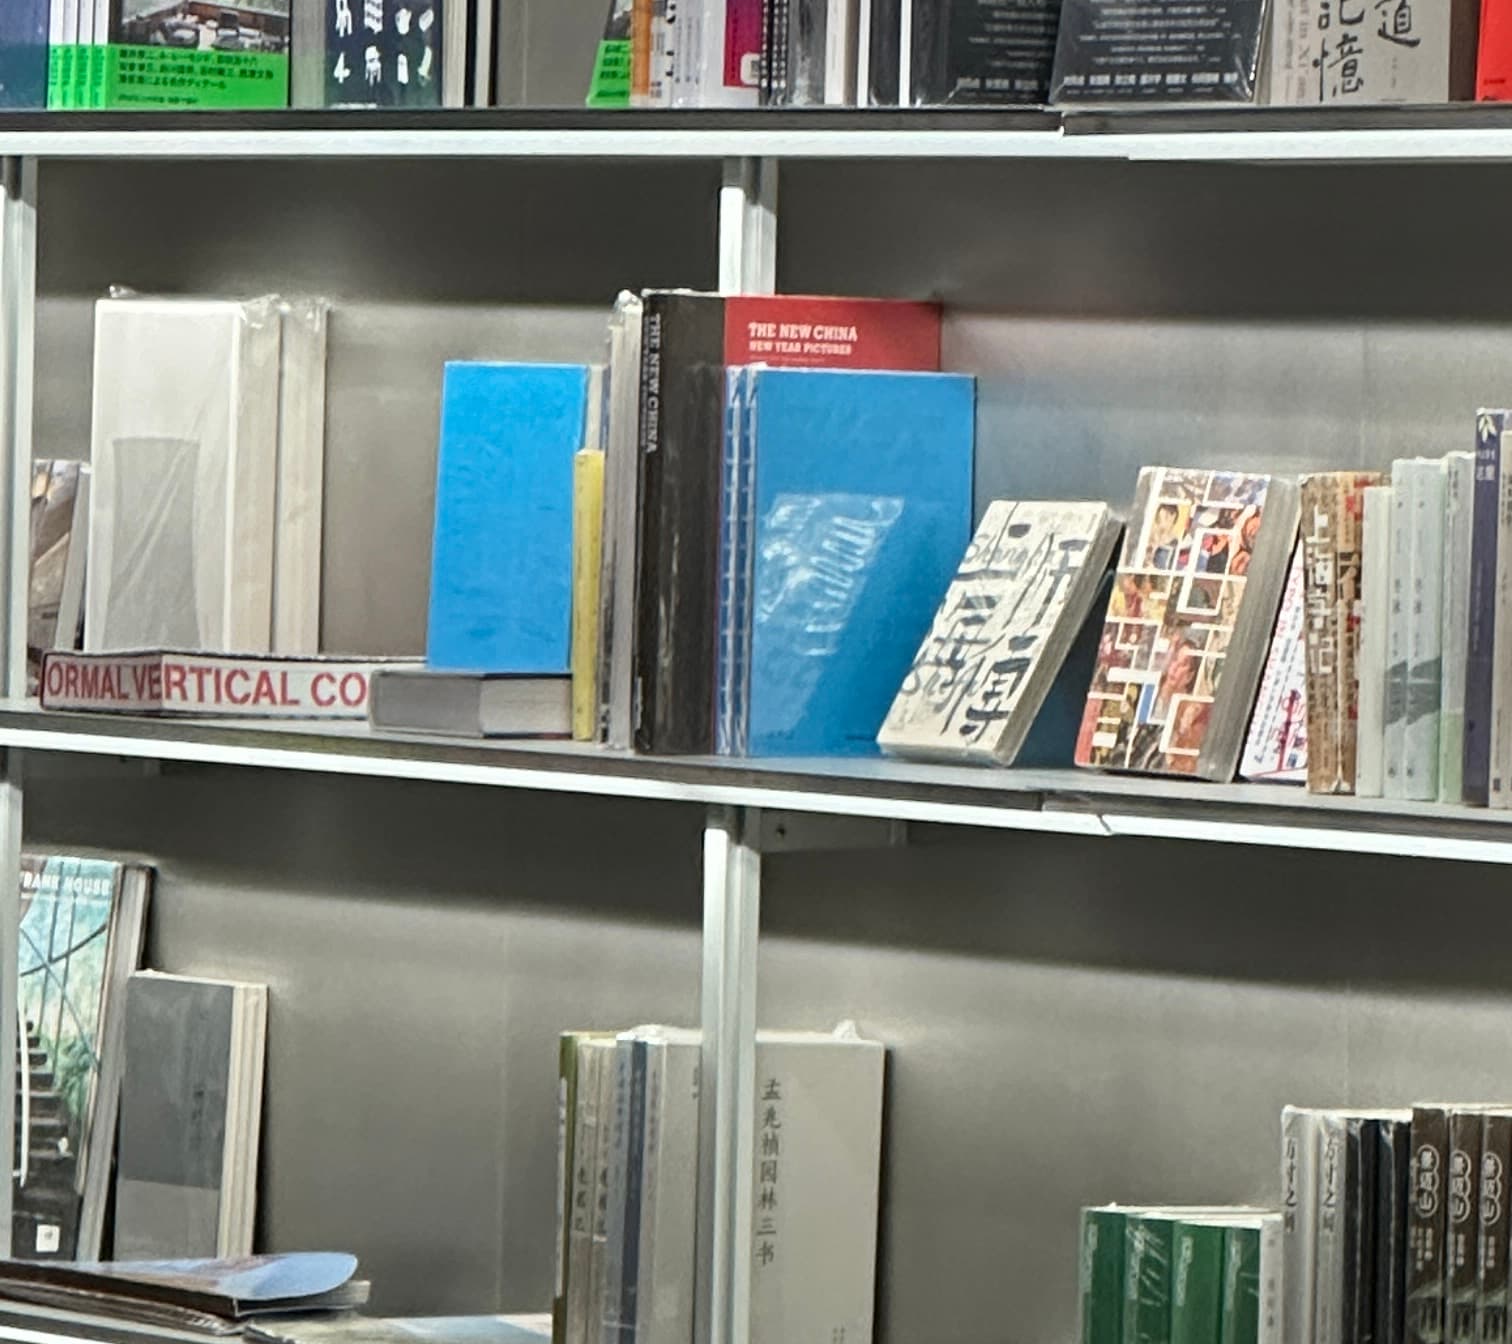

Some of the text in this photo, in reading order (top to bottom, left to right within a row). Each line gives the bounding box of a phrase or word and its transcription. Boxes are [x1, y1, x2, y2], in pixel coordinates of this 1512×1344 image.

[748, 321, 858, 342] THE NEW CHINA
[748, 340, 853, 356] NEW YEAR PICTURES
[131, 663, 301, 707] VERTICAL
[62, 875, 112, 897] HOUSE
